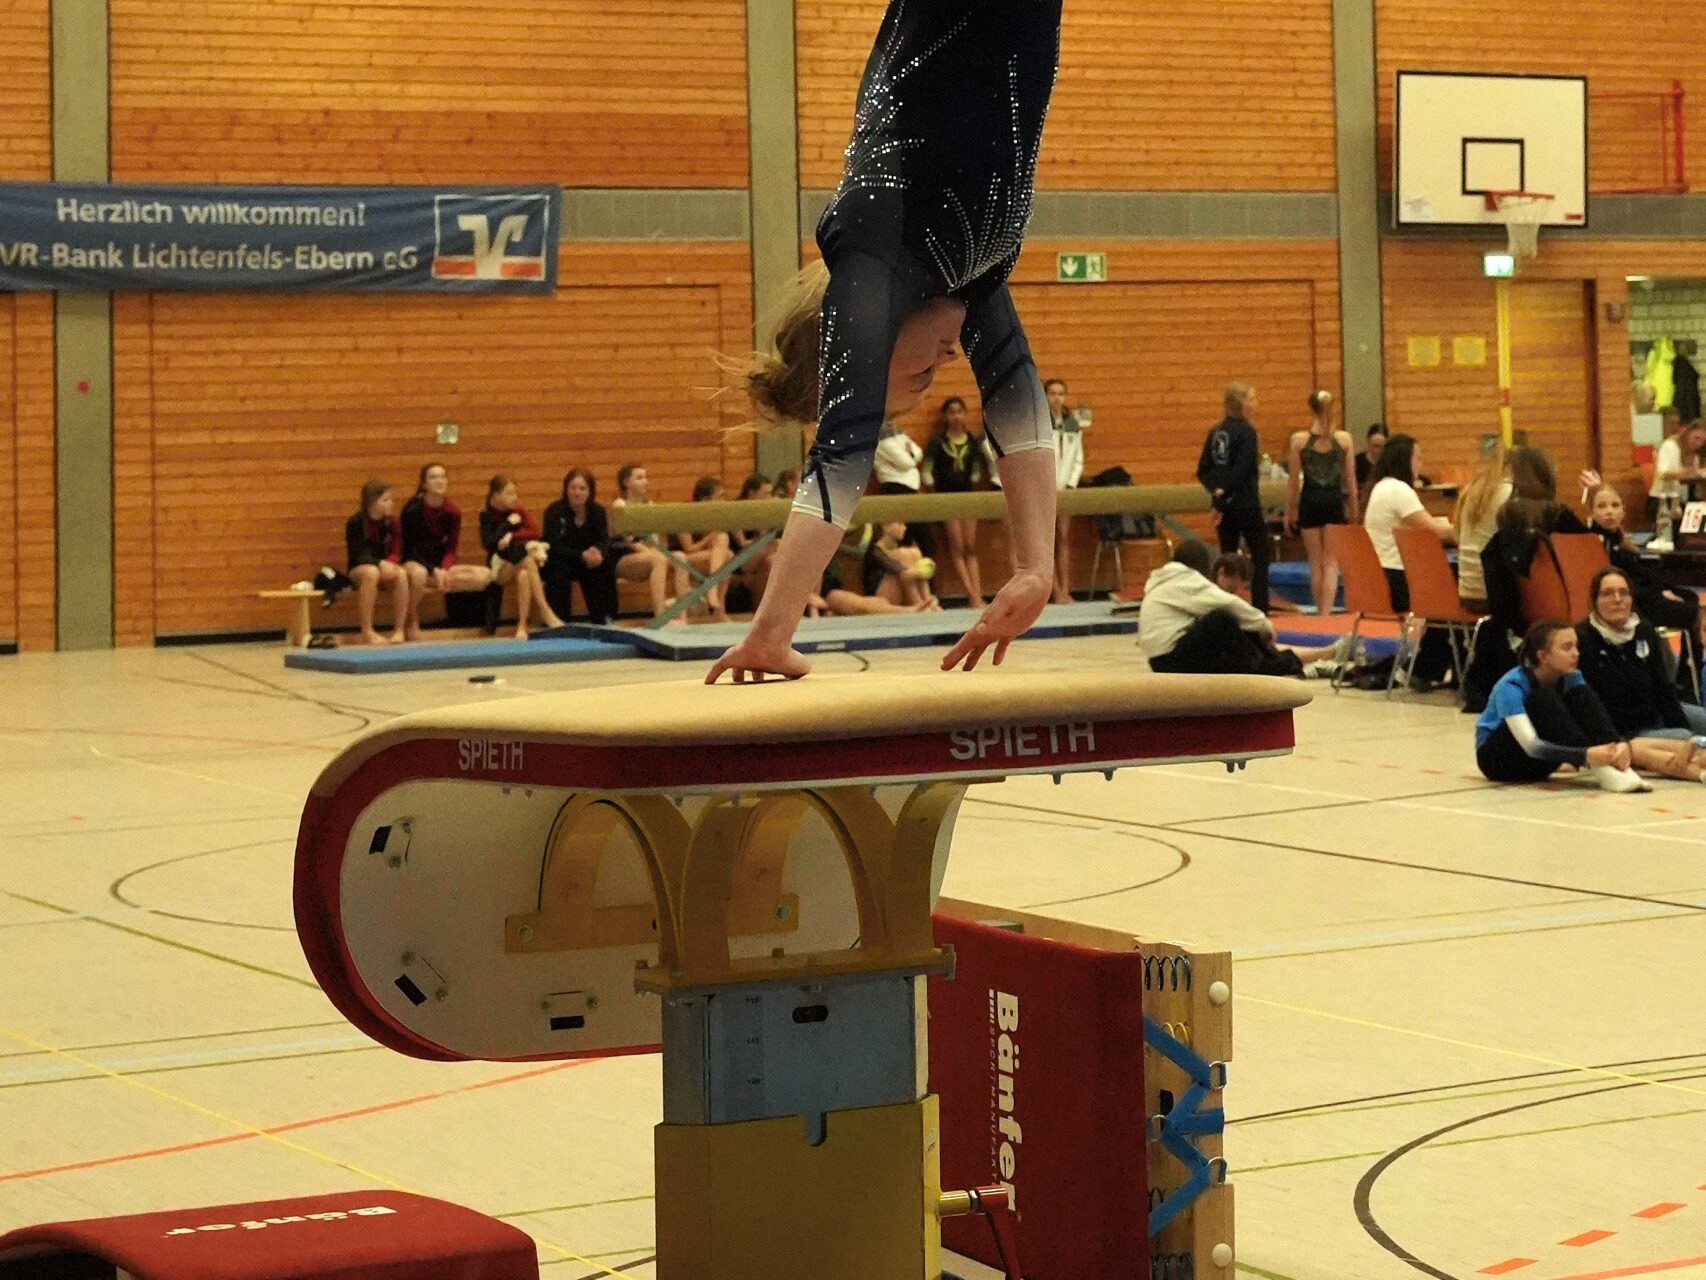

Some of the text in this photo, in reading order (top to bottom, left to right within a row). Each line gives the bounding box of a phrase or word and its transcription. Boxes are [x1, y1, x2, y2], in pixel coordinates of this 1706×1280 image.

[56, 197, 366, 226] Herzlich willkommen!
[0, 241, 418, 270] VR-Bank Lichtenfels-Ebern eG
[458, 738, 524, 770] SPIETH
[950, 720, 1096, 761] SPIETH
